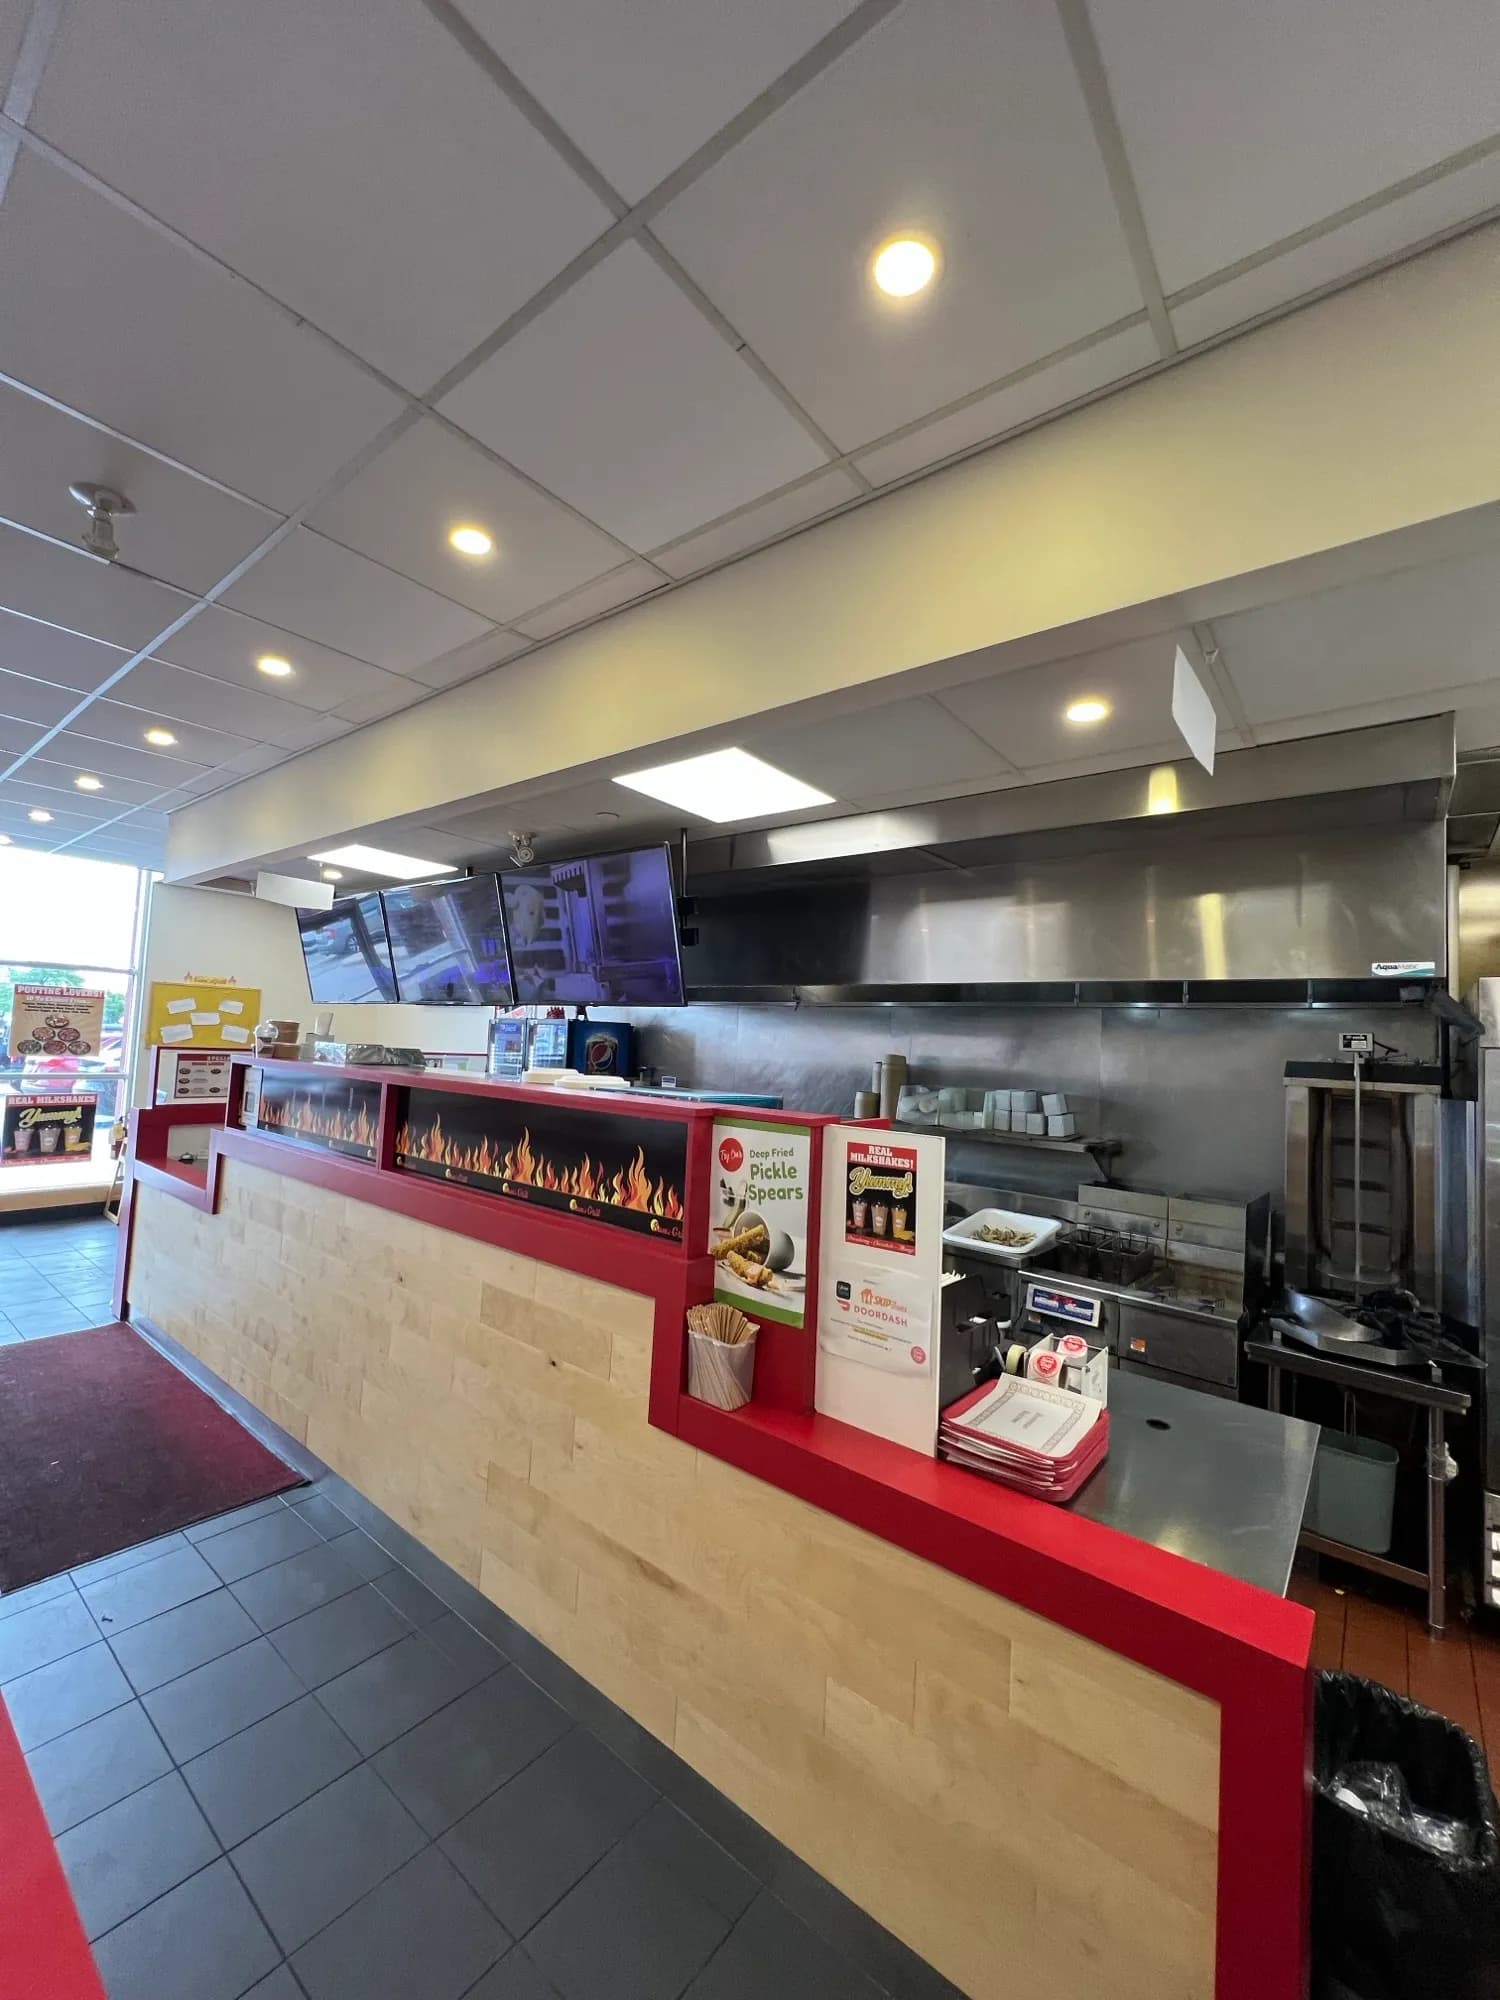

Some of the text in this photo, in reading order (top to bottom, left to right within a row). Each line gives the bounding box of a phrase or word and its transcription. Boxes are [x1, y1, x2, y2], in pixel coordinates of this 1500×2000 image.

[8, 1094, 96, 1105] REAL MILKSHAKES
[749, 1147, 794, 1160] Deep Fried
[868, 1145, 892, 1157] REAL
[850, 1152, 914, 1169] MILKSHAKES!
[750, 1161, 798, 1180] Pickle
[748, 1184, 804, 1205] Spears
[854, 1305, 908, 1328] DOORDASH
